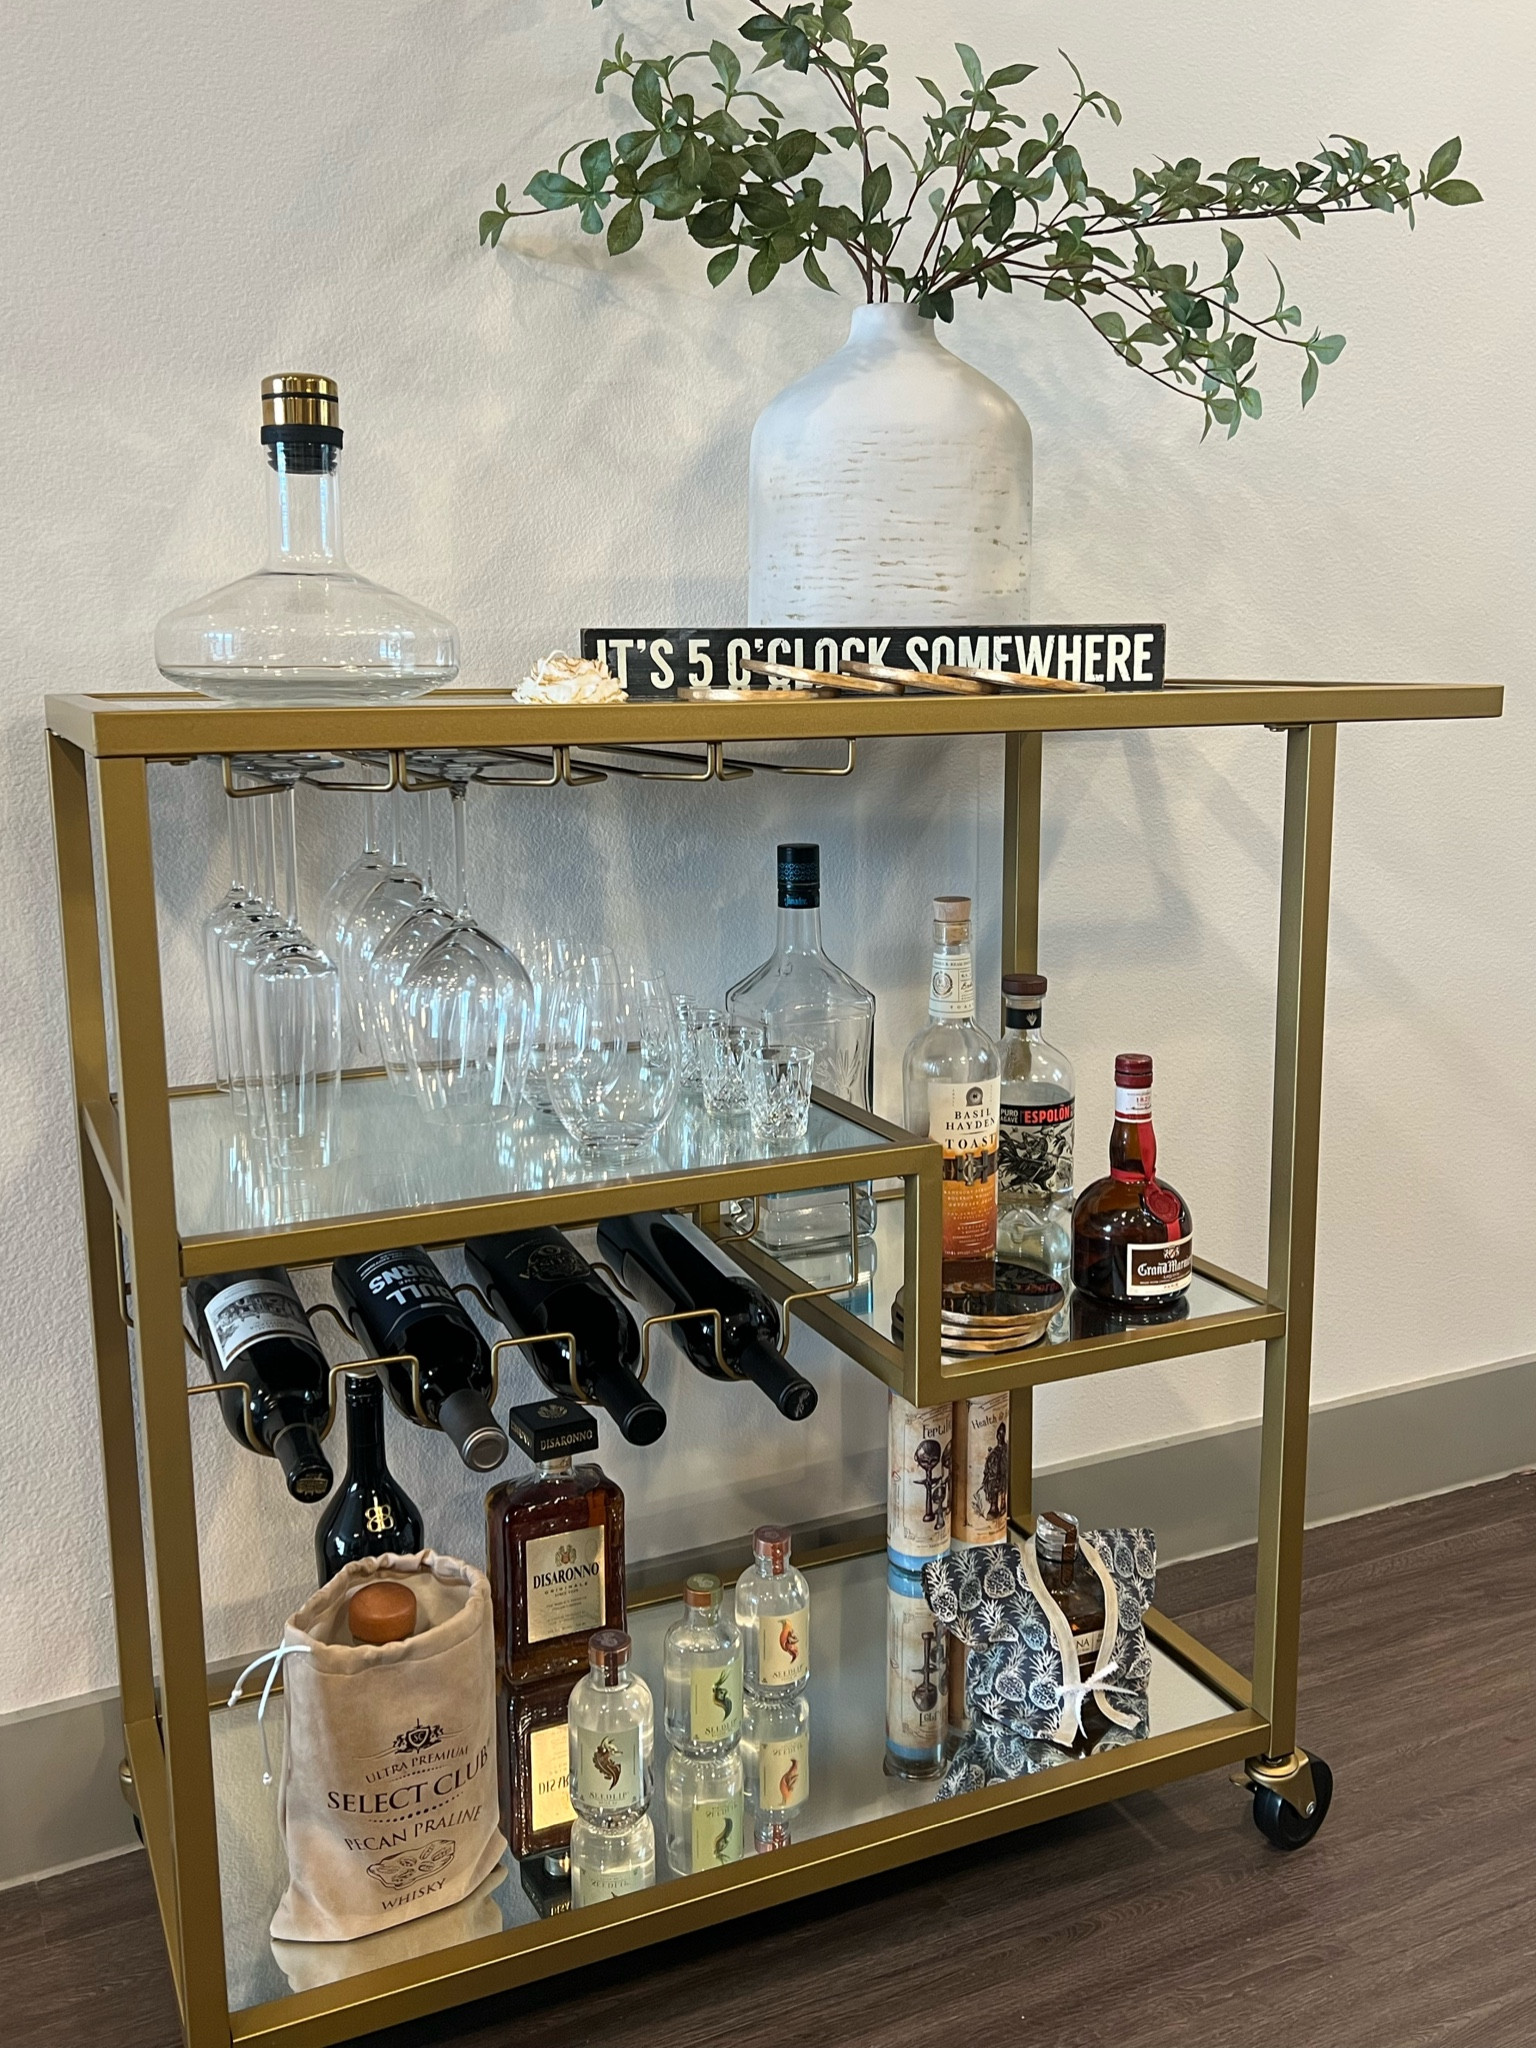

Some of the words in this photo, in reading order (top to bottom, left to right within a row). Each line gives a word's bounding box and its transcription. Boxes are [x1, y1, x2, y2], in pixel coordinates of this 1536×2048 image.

[596, 638, 675, 690] IT'S
[688, 638, 714, 688] 5
[726, 636, 892, 690] O'CLOCK
[905, 633, 1155, 683] SOMEWHERE
[945, 1117, 996, 1131] HAYDEN
[954, 1107, 992, 1120] BASIL
[945, 1133, 997, 1150] TOAST
[386, 1283, 456, 1305] BULL
[971, 1413, 998, 1430] Health
[540, 1430, 593, 1451] DISARONNO
[533, 1561, 600, 1590] DISARONNO
[365, 1761, 409, 1784] ULTRA
[411, 1745, 470, 1767] PREMIUM
[327, 1781, 429, 1814] SELECT
[433, 1745, 488, 1796] CLUB
[343, 1828, 407, 1851] PECAN
[414, 1804, 483, 1837] PRALINE
[381, 1877, 447, 1911] WHISKY
